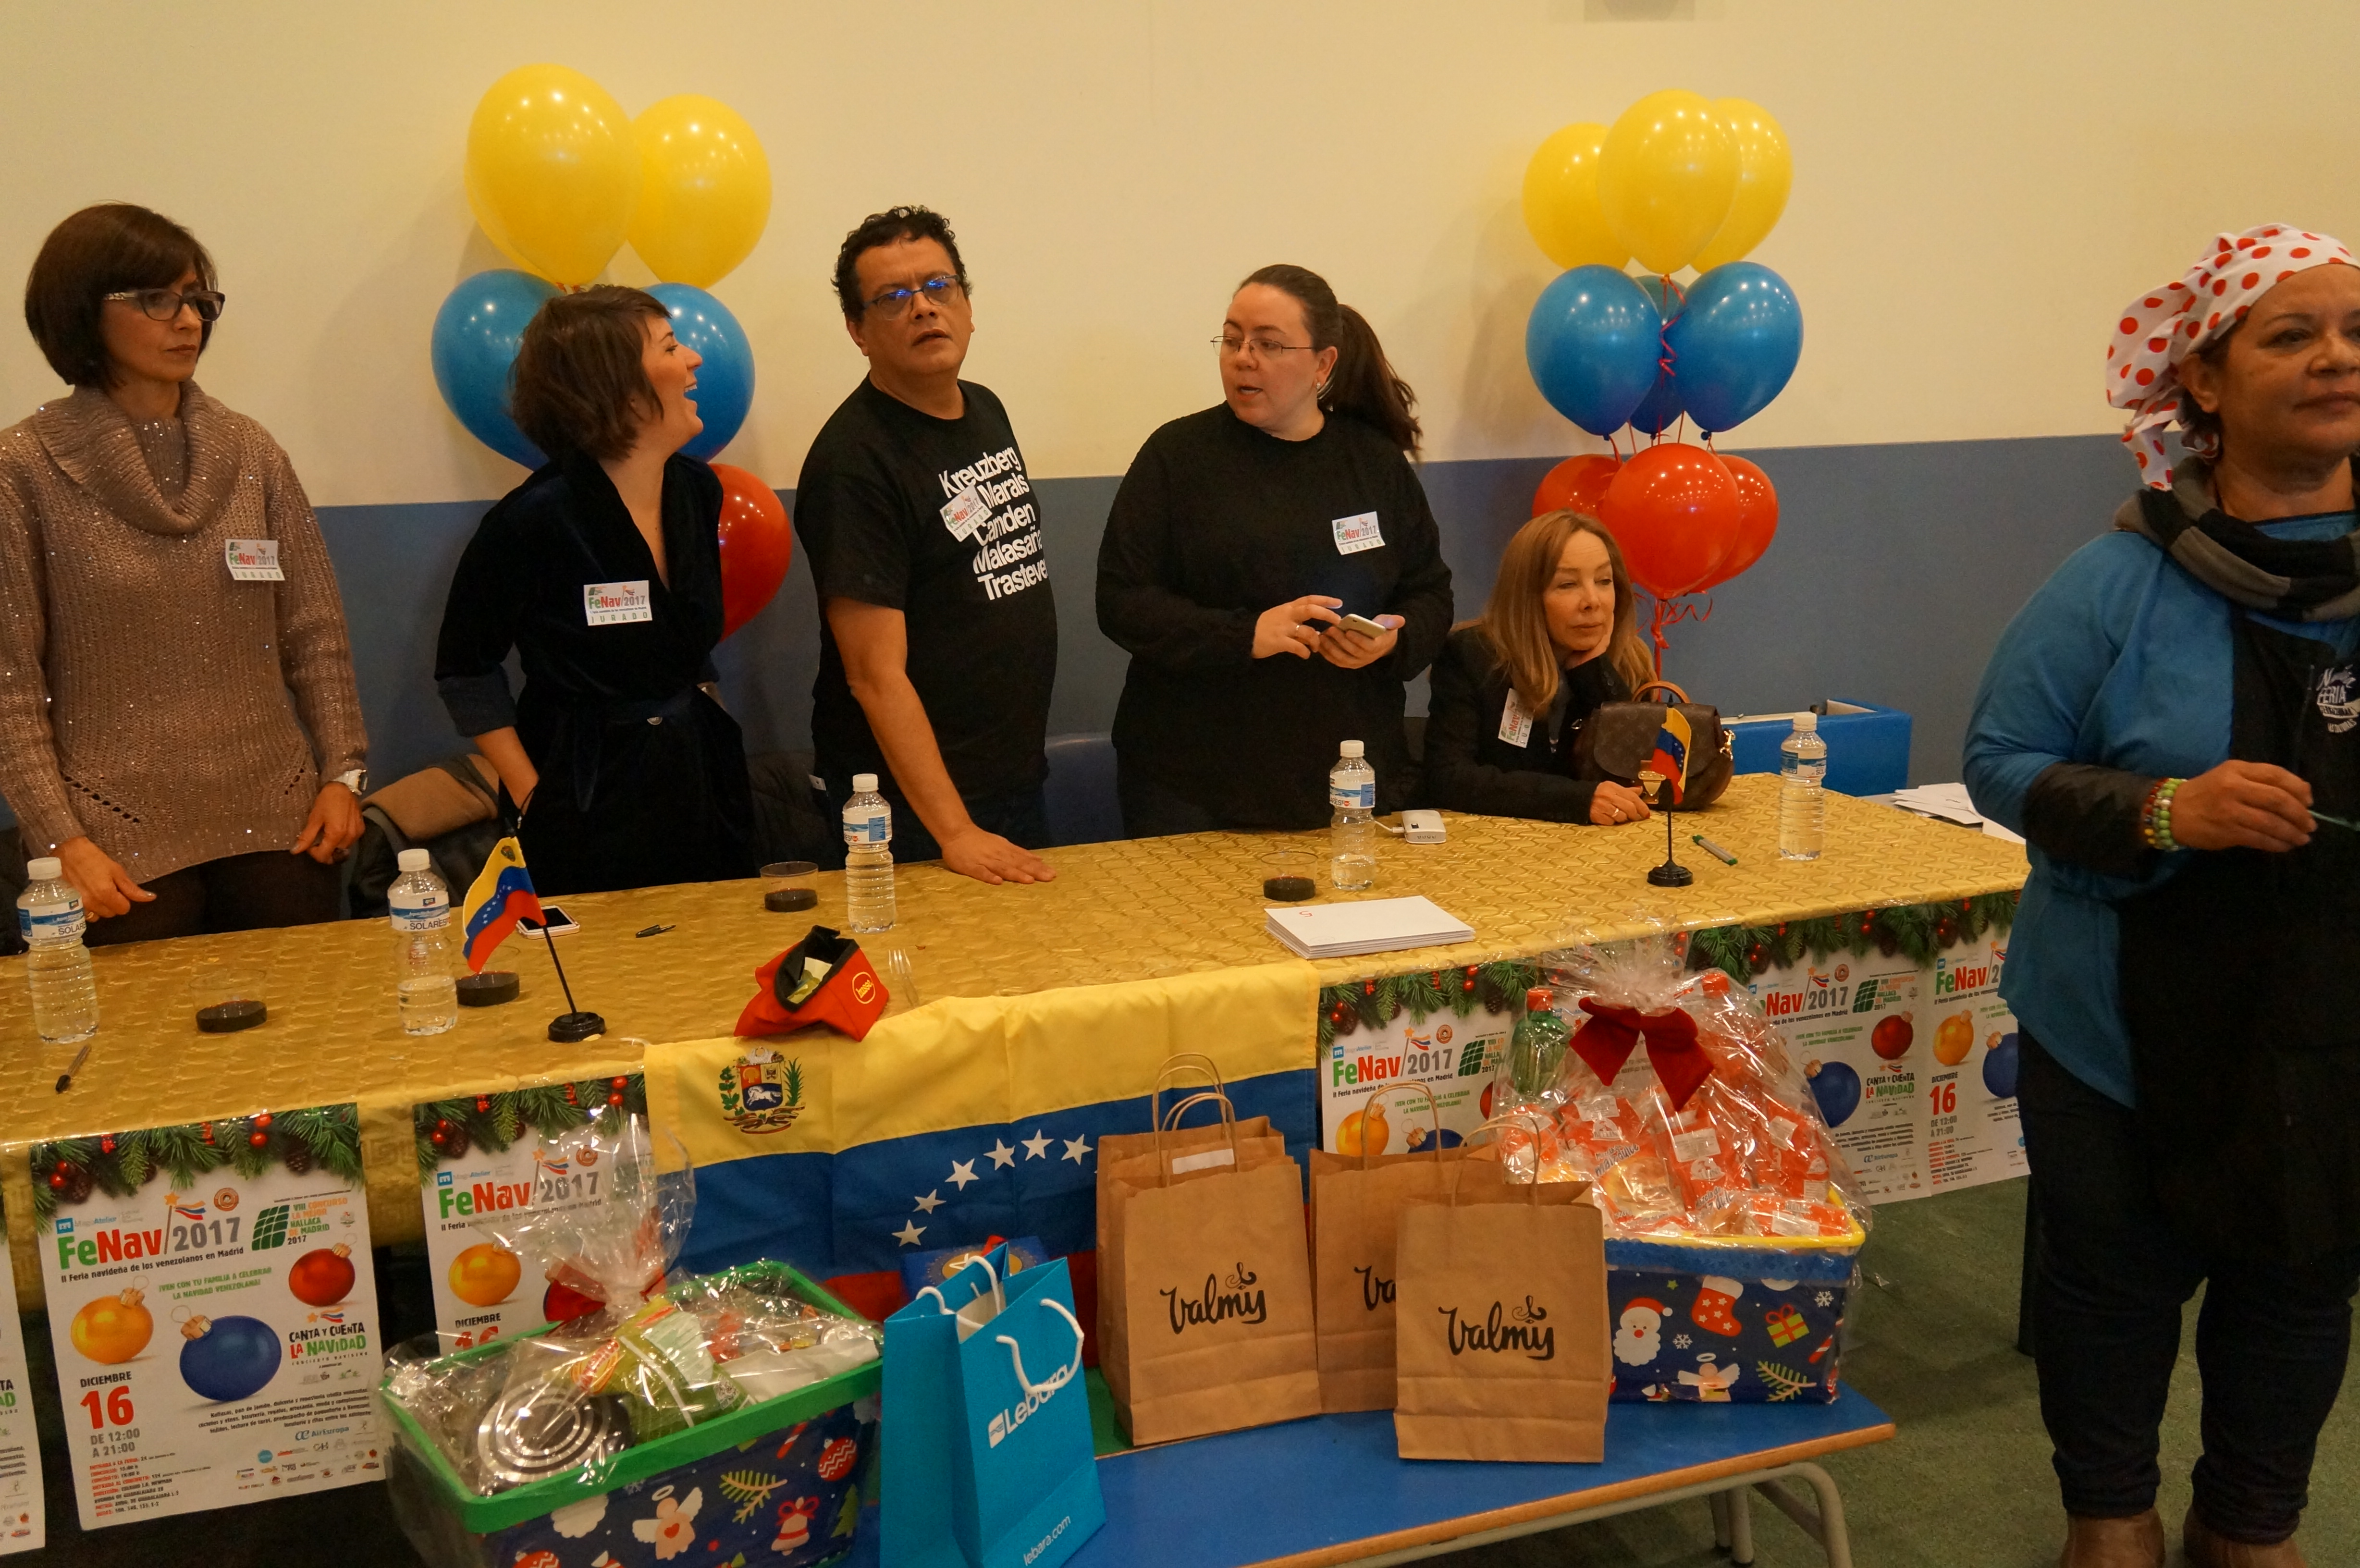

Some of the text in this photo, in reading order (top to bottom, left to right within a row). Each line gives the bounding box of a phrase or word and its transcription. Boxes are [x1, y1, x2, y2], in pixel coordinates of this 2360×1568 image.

[938, 447, 1022, 499] Kreuzberg
[977, 472, 1030, 509] Marais
[972, 503, 1036, 546] Camden
[1337, 528, 1360, 541] FeNav
[1361, 525, 1377, 536] 2017
[973, 525, 1043, 575] Malasaña
[229, 553, 256, 565] FeNav
[977, 558, 1049, 600] Trasteve
[589, 595, 646, 609] FeNav 2017
[58, 921, 86, 935] SOLARE
[409, 918, 447, 930] SOLARES
[1936, 966, 1987, 995] FeNav
[1808, 986, 1849, 1010] 2017
[1333, 1048, 1453, 1088] FeNav 2017
[1482, 1065, 1495, 1073] 2017
[1867, 1076, 1886, 1086] CANTA
[1892, 1073, 1915, 1083] CUENTA
[1931, 1071, 1958, 1083] DICIEMBRE
[1352, 1086, 1376, 1095] navideña
[1866, 1087, 1874, 1099] LA
[1930, 1082, 1956, 1115] 16
[1931, 1118, 1939, 1127] DE
[1930, 1129, 1935, 1138] A
[438, 1182, 530, 1219] FeNav
[540, 1171, 599, 1203] 2017
[300, 1224, 331, 1235] MADRID
[448, 1221, 466, 1230] Feria
[57, 1216, 241, 1271] FeNav 2017
[288, 1235, 307, 1245] 2017
[61, 1247, 244, 1283] II Feria navideña de los venezolanos en Madrid
[177, 1280, 191, 1288] CON
[204, 1274, 231, 1284] FAMILIA
[183, 1286, 214, 1298] NAVIDAD
[1159, 1272, 1267, 1335] Valmy
[455, 1312, 502, 1328] DICIEMBRE
[289, 1328, 320, 1343] CANTA
[329, 1322, 366, 1336] CUENTA
[1438, 1300, 1555, 1361] Valmy
[290, 1343, 304, 1359] LA
[80, 1371, 132, 1388] DICIEMBRE
[80, 1385, 134, 1429] 16
[90, 1428, 140, 1445] DE 12:00
[311, 1426, 349, 1437] AirEuropa
[92, 1442, 135, 1458] A 21:00
[1023, 1515, 1071, 1567] lebara.com
